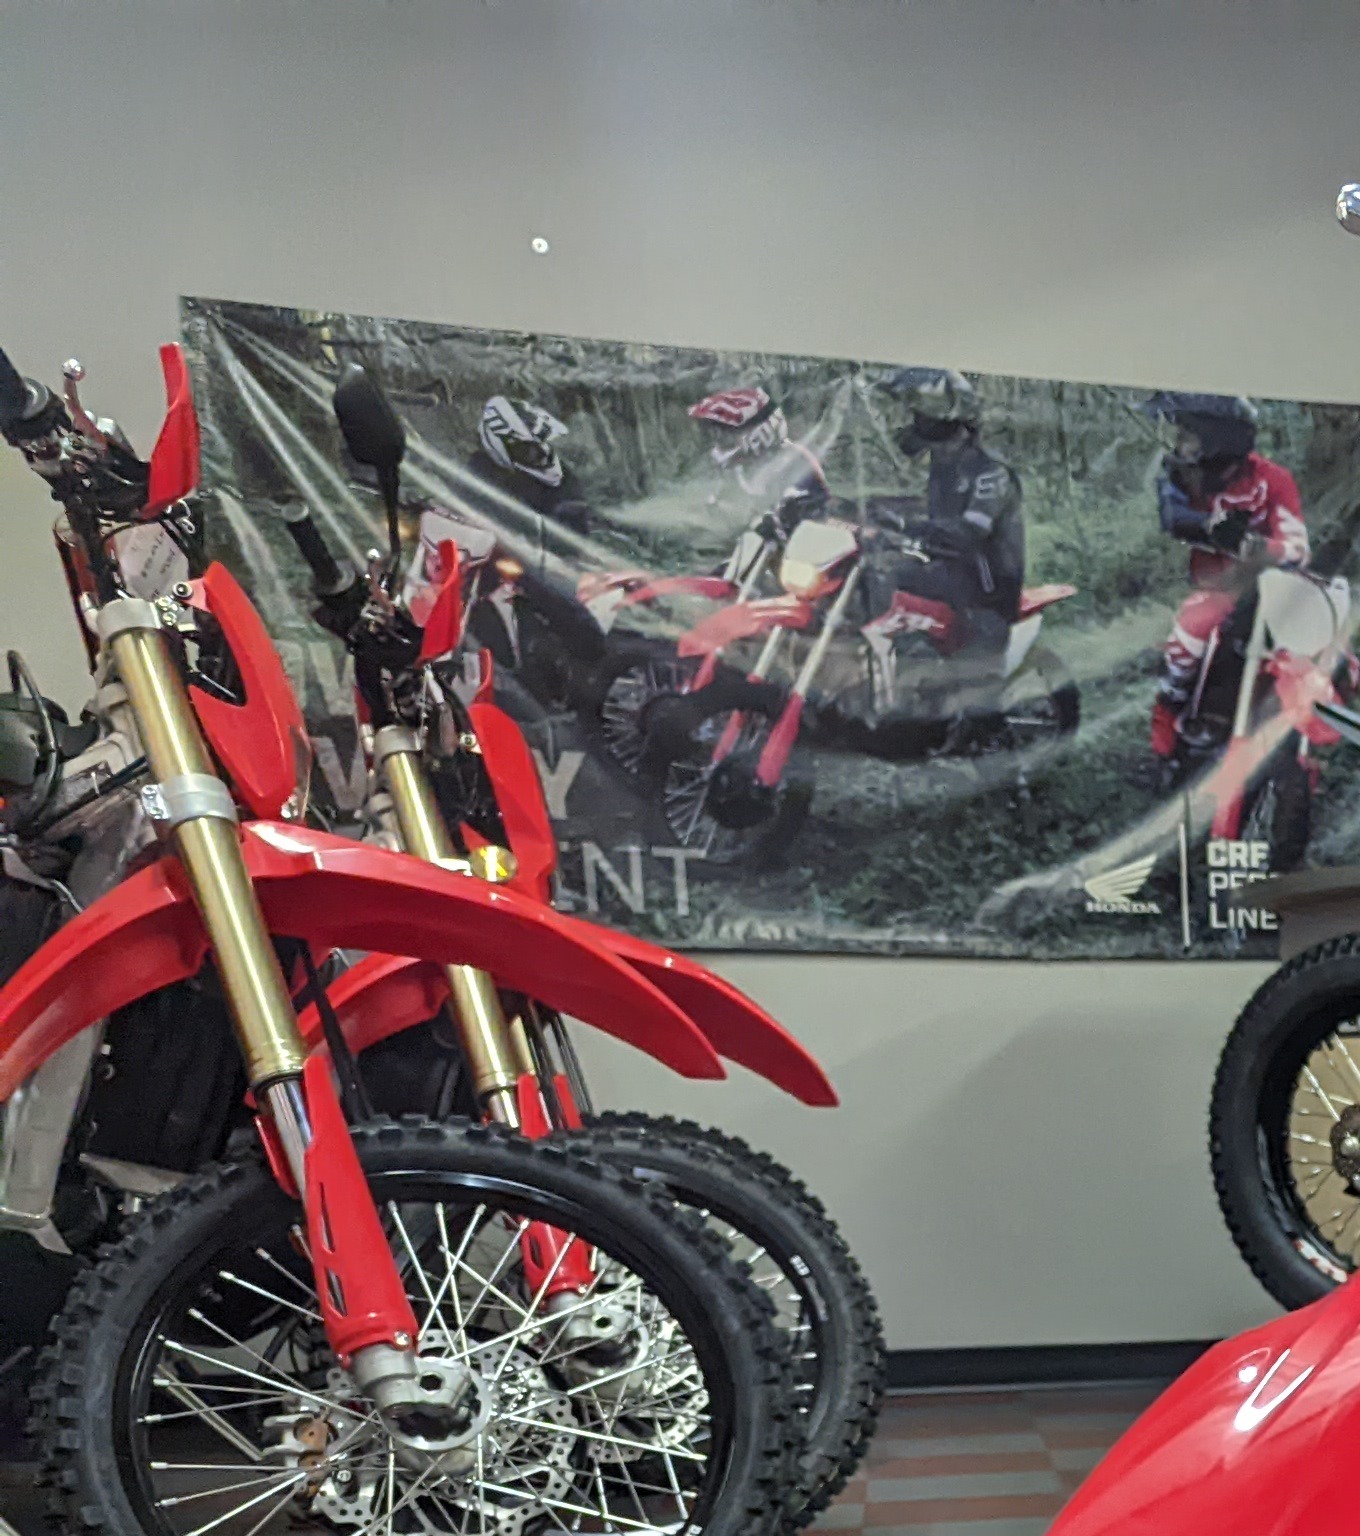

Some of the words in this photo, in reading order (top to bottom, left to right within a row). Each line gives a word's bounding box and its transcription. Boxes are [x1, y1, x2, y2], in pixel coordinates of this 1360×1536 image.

[1206, 840, 1270, 869] CRF
[1086, 901, 1161, 914] HONDA
[1208, 901, 1279, 930] LINE
